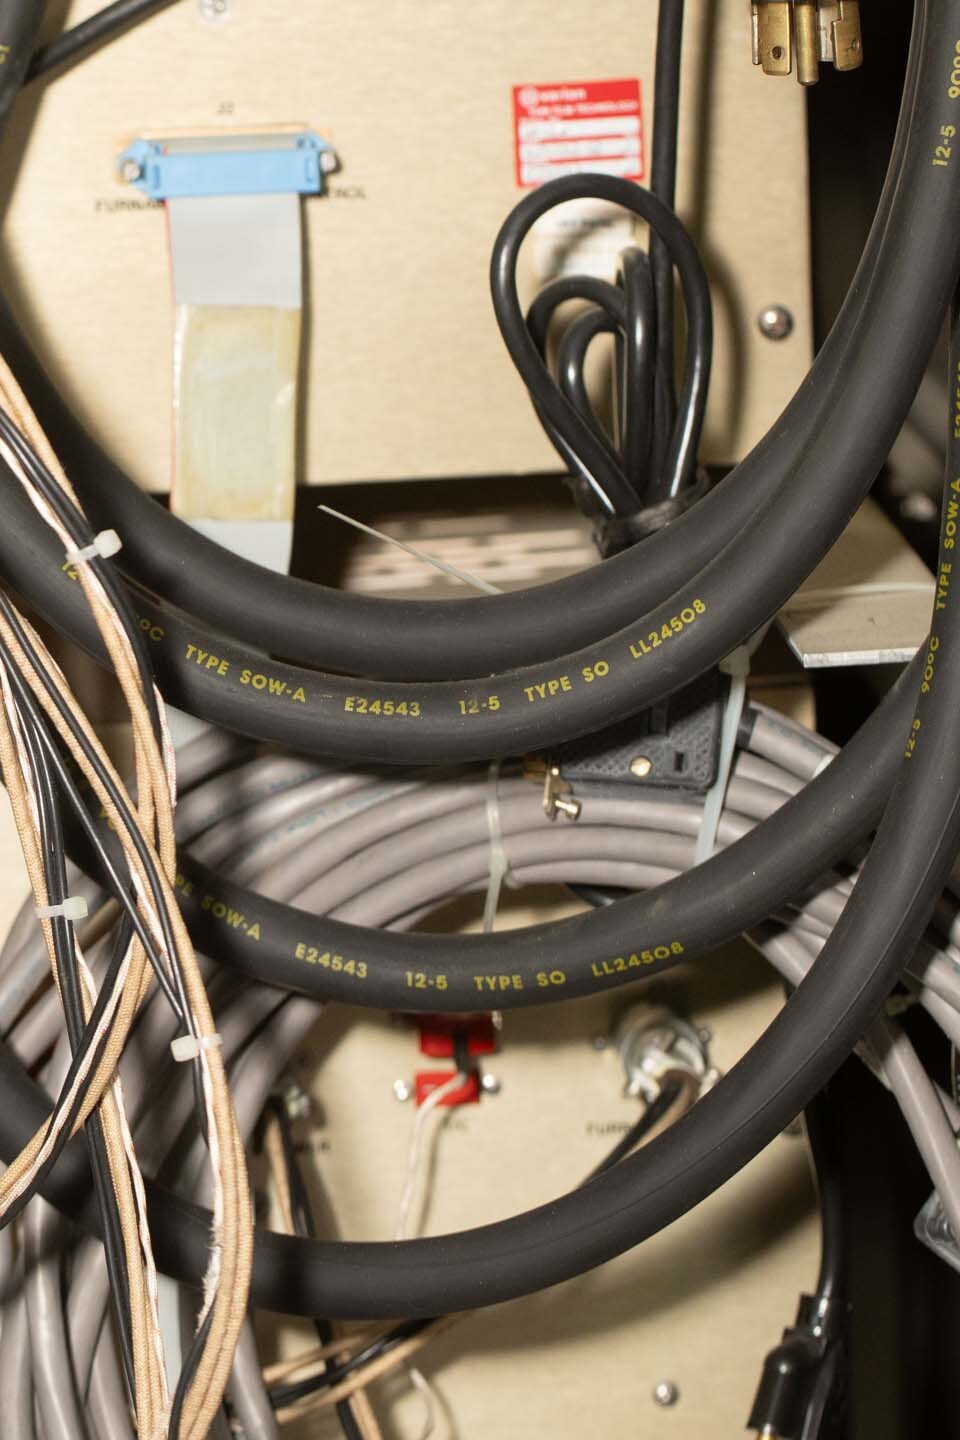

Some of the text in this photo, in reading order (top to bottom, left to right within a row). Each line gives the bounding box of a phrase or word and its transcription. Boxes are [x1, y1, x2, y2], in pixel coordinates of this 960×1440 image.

[932, 124, 956, 167] 12-5
[936, 562, 953, 611] TYPE
[628, 598, 708, 660] LL24508
[185, 643, 610, 718] TYPE SOW-A E24543 12-5 TYPE SO
[200, 895, 263, 941] SOW-A
[295, 941, 369, 980] E24543
[405, 971, 449, 991] 12-5
[474, 975, 524, 992] TYPE
[536, 971, 567, 987] SO
[591, 941, 685, 979] LL24508
